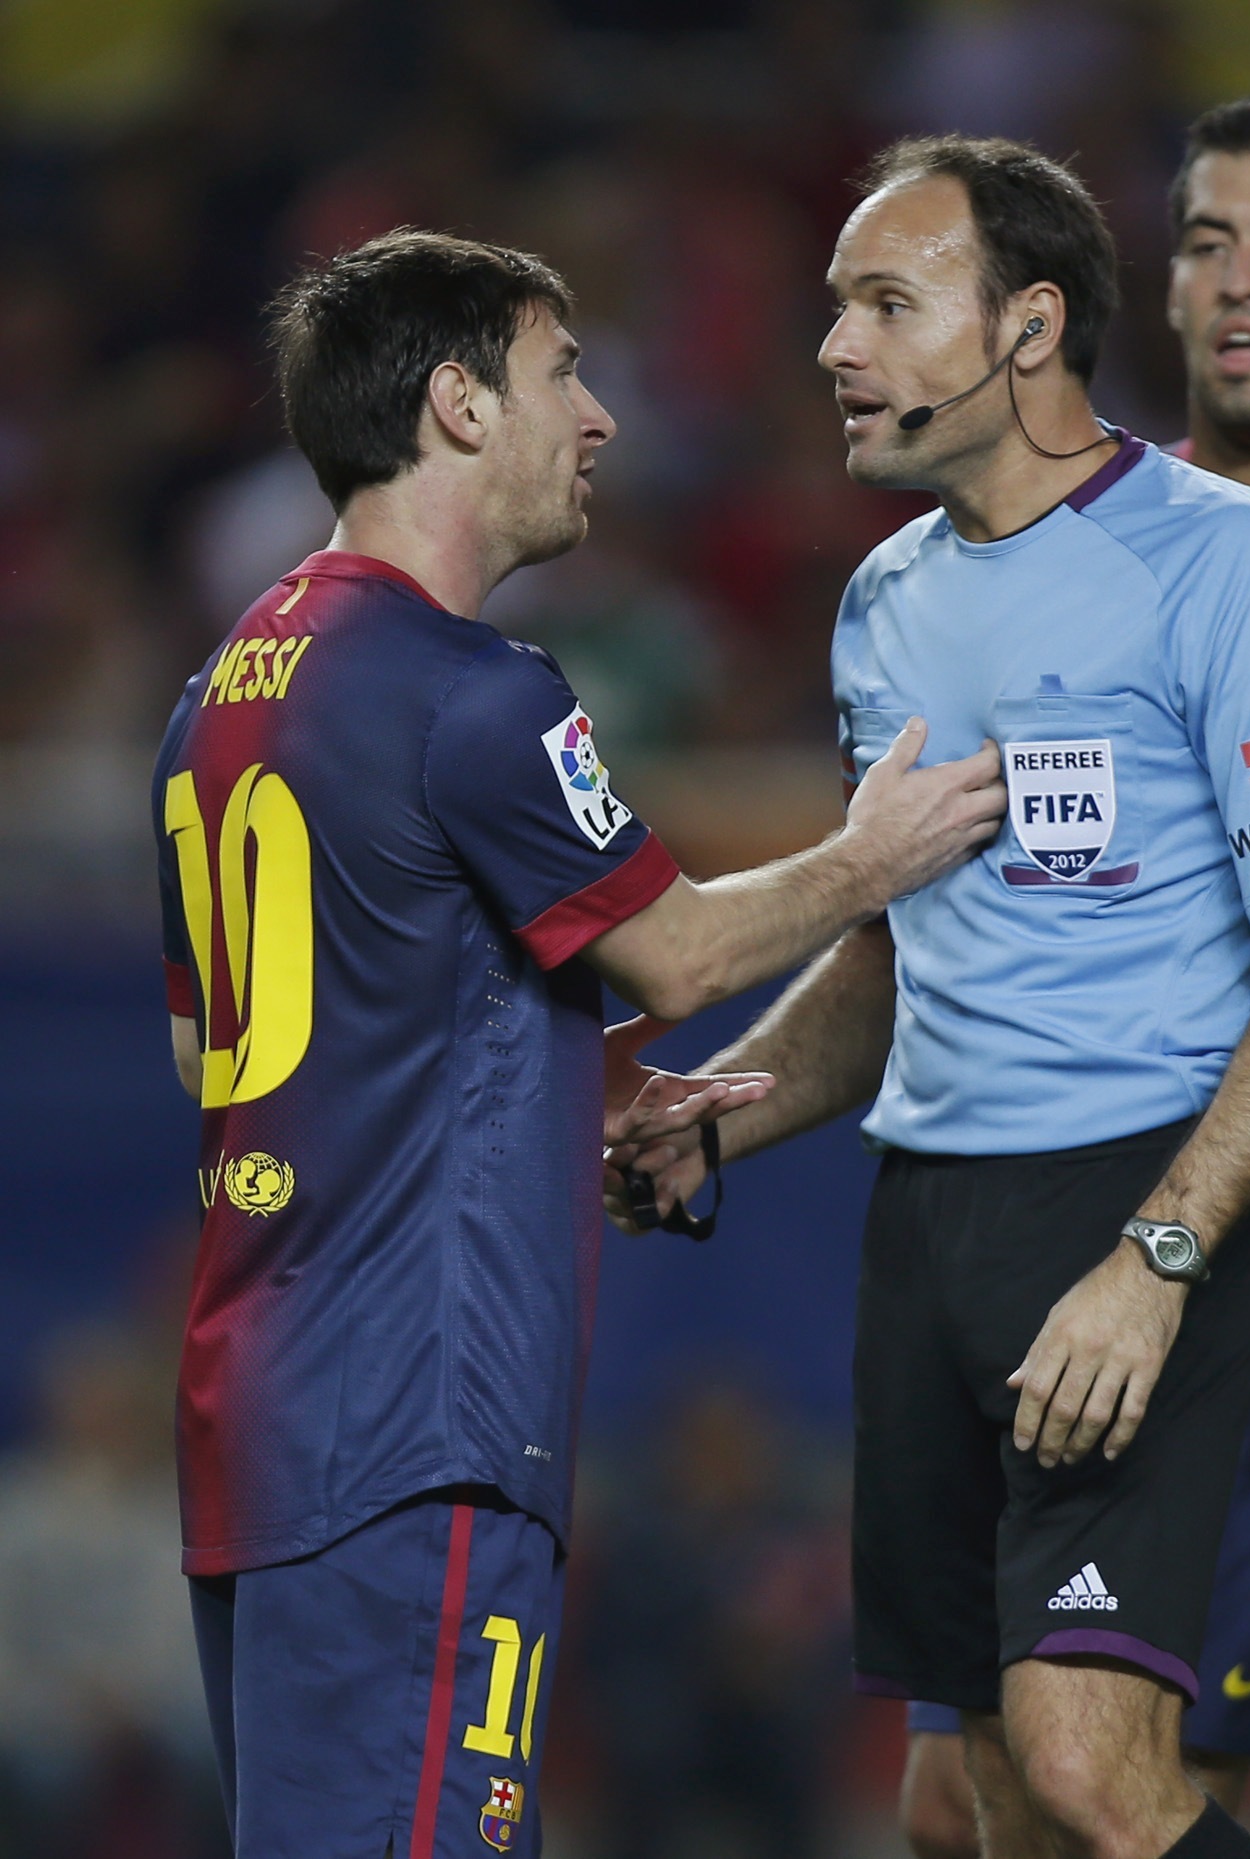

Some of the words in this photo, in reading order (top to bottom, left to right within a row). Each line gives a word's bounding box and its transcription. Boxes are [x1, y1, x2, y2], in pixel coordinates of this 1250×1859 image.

[201, 635, 313, 708] MESSI
[1014, 751, 1104, 770] REFEREE
[582, 787, 630, 841] LF
[1023, 793, 1103, 824] FIFA
[1049, 854, 1086, 869] 2012
[164, 762, 313, 1109] 10
[1047, 1592, 1119, 1611] adidas
[499, 1808, 516, 1820] FCB
